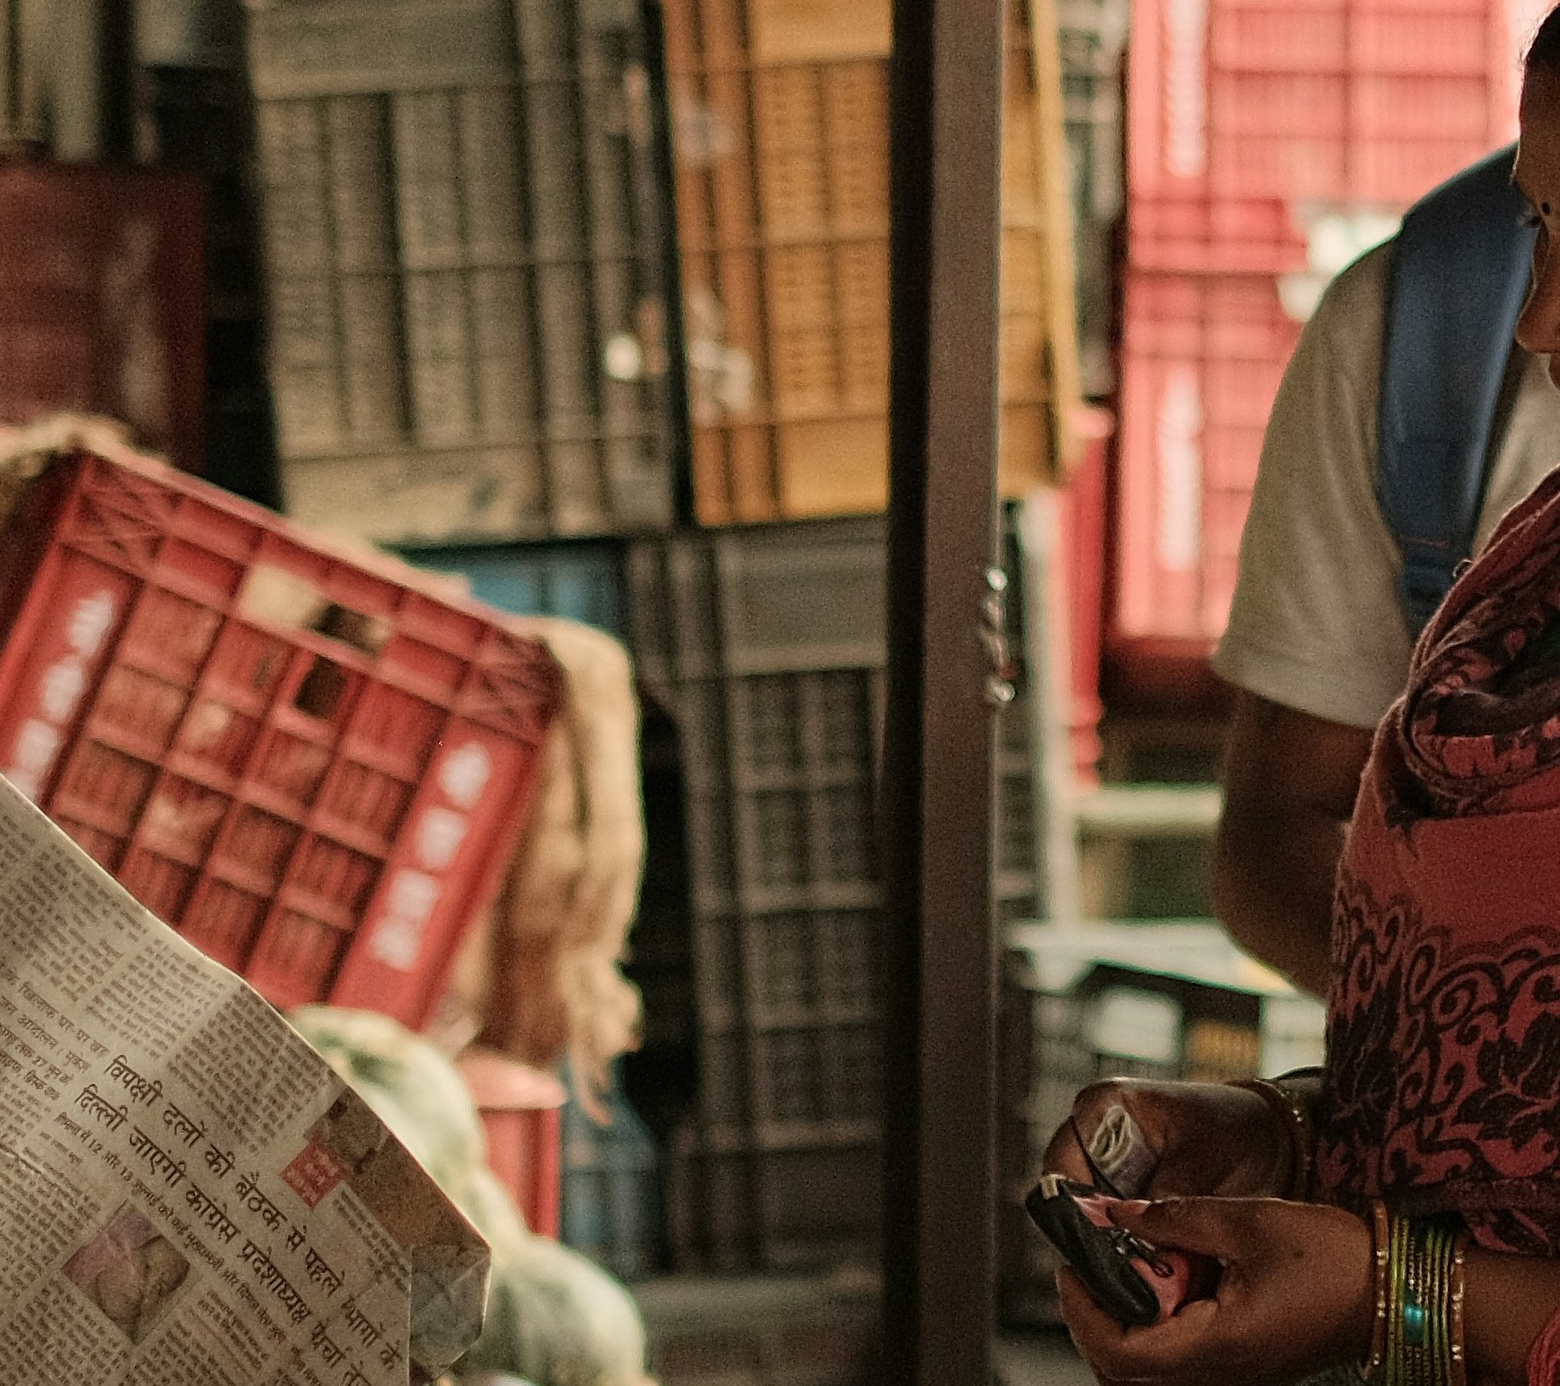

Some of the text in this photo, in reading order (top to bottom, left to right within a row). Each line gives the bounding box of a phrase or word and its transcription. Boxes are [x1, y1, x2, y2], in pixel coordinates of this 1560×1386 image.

[18, 981, 60, 1019] खिलाफ
[17, 1013, 59, 1050] आंदोलन
[15, 1041, 36, 1058] तक
[31, 1055, 48, 1067] 27
[103, 1054, 164, 1108] विपक्षी
[162, 1101, 208, 1149] दलों
[204, 1143, 236, 1179] की
[235, 1171, 288, 1232] बैठक
[285, 1224, 308, 1253] से
[304, 1246, 346, 1298] पहले
[74, 1083, 129, 1133] दिल्ली
[128, 1125, 187, 1188] जाएंगी
[185, 1181, 242, 1245] कांग्रेस
[236, 1238, 314, 1327] प्रदेशाध्यक्ष
[87, 1138, 104, 1155] 12
[101, 1150, 122, 1170] और
[119, 1166, 134, 1182] 13
[131, 1178, 164, 1207] जुलाई
[157, 1202, 174, 1220] को
[170, 1216, 192, 1236] कई
[183, 1232, 225, 1272] मुख्यमंत्री
[221, 1268, 240, 1288] और
[379, 1339, 403, 1372] के
